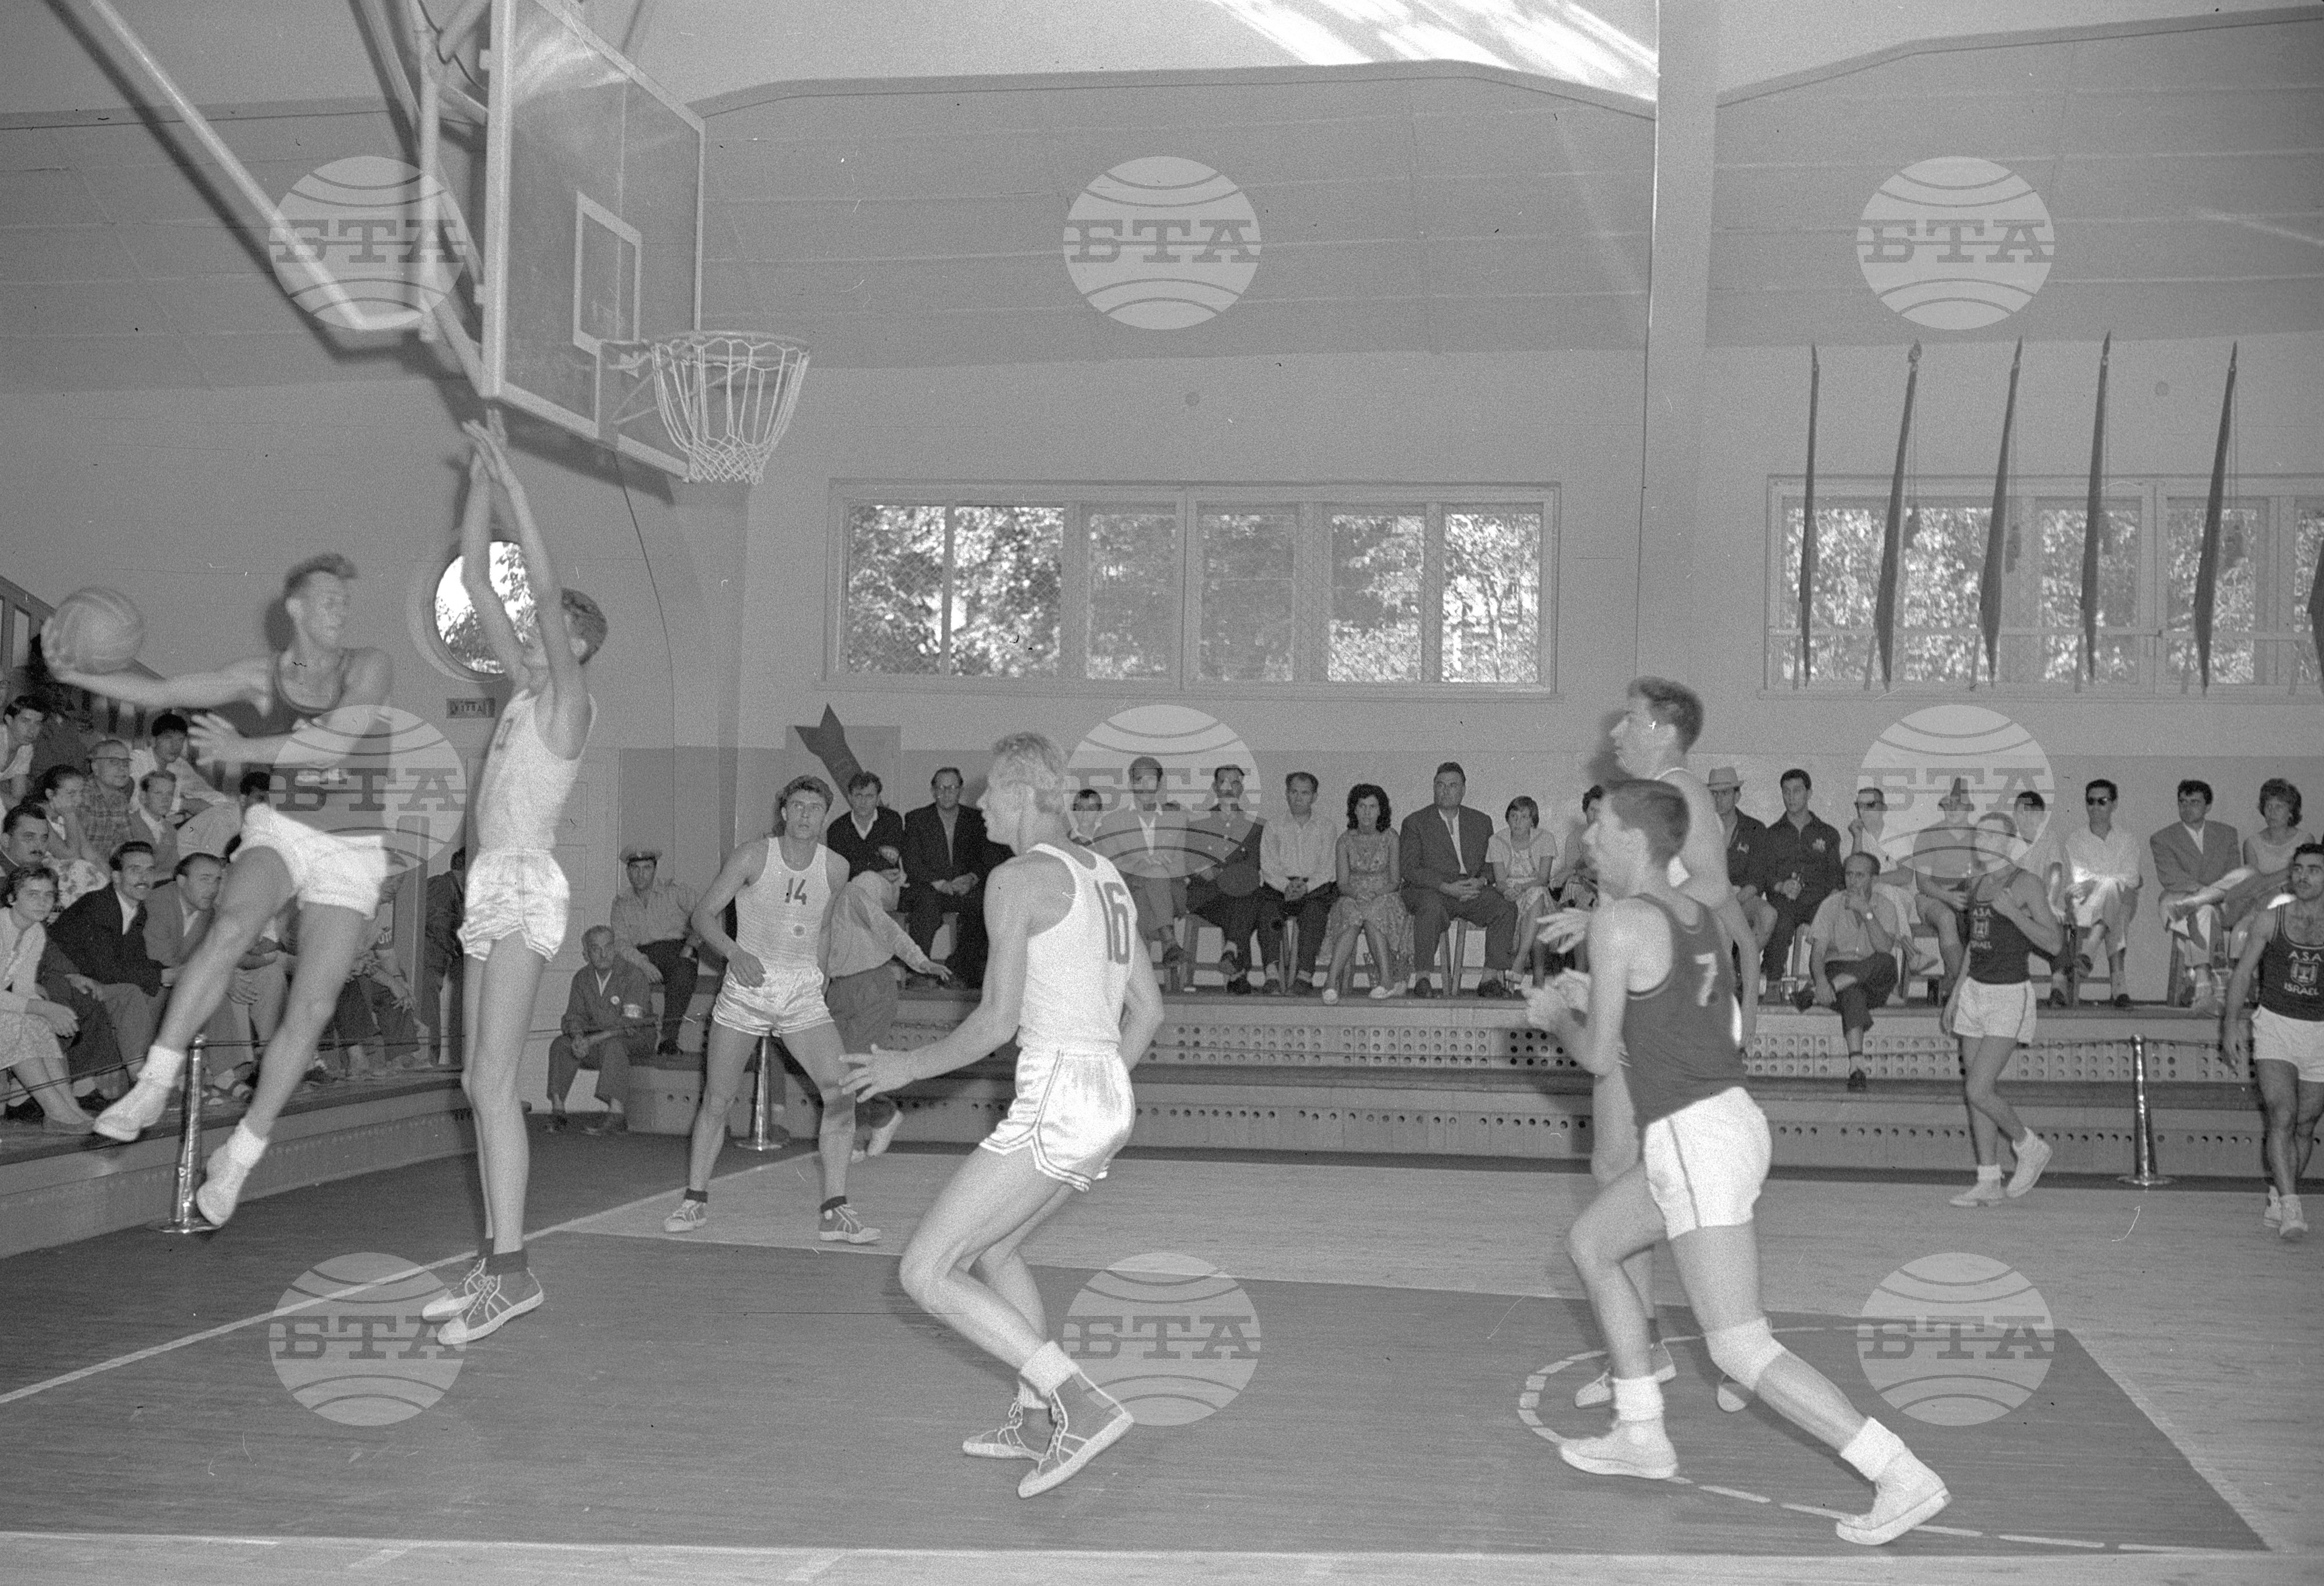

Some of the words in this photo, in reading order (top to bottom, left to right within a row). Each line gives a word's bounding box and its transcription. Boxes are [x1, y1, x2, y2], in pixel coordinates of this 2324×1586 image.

[784, 877, 807, 905] 14
[1094, 880, 1130, 964] 16
[1695, 952, 1718, 1007] 7
[2284, 982, 2319, 996] ISRAEL
